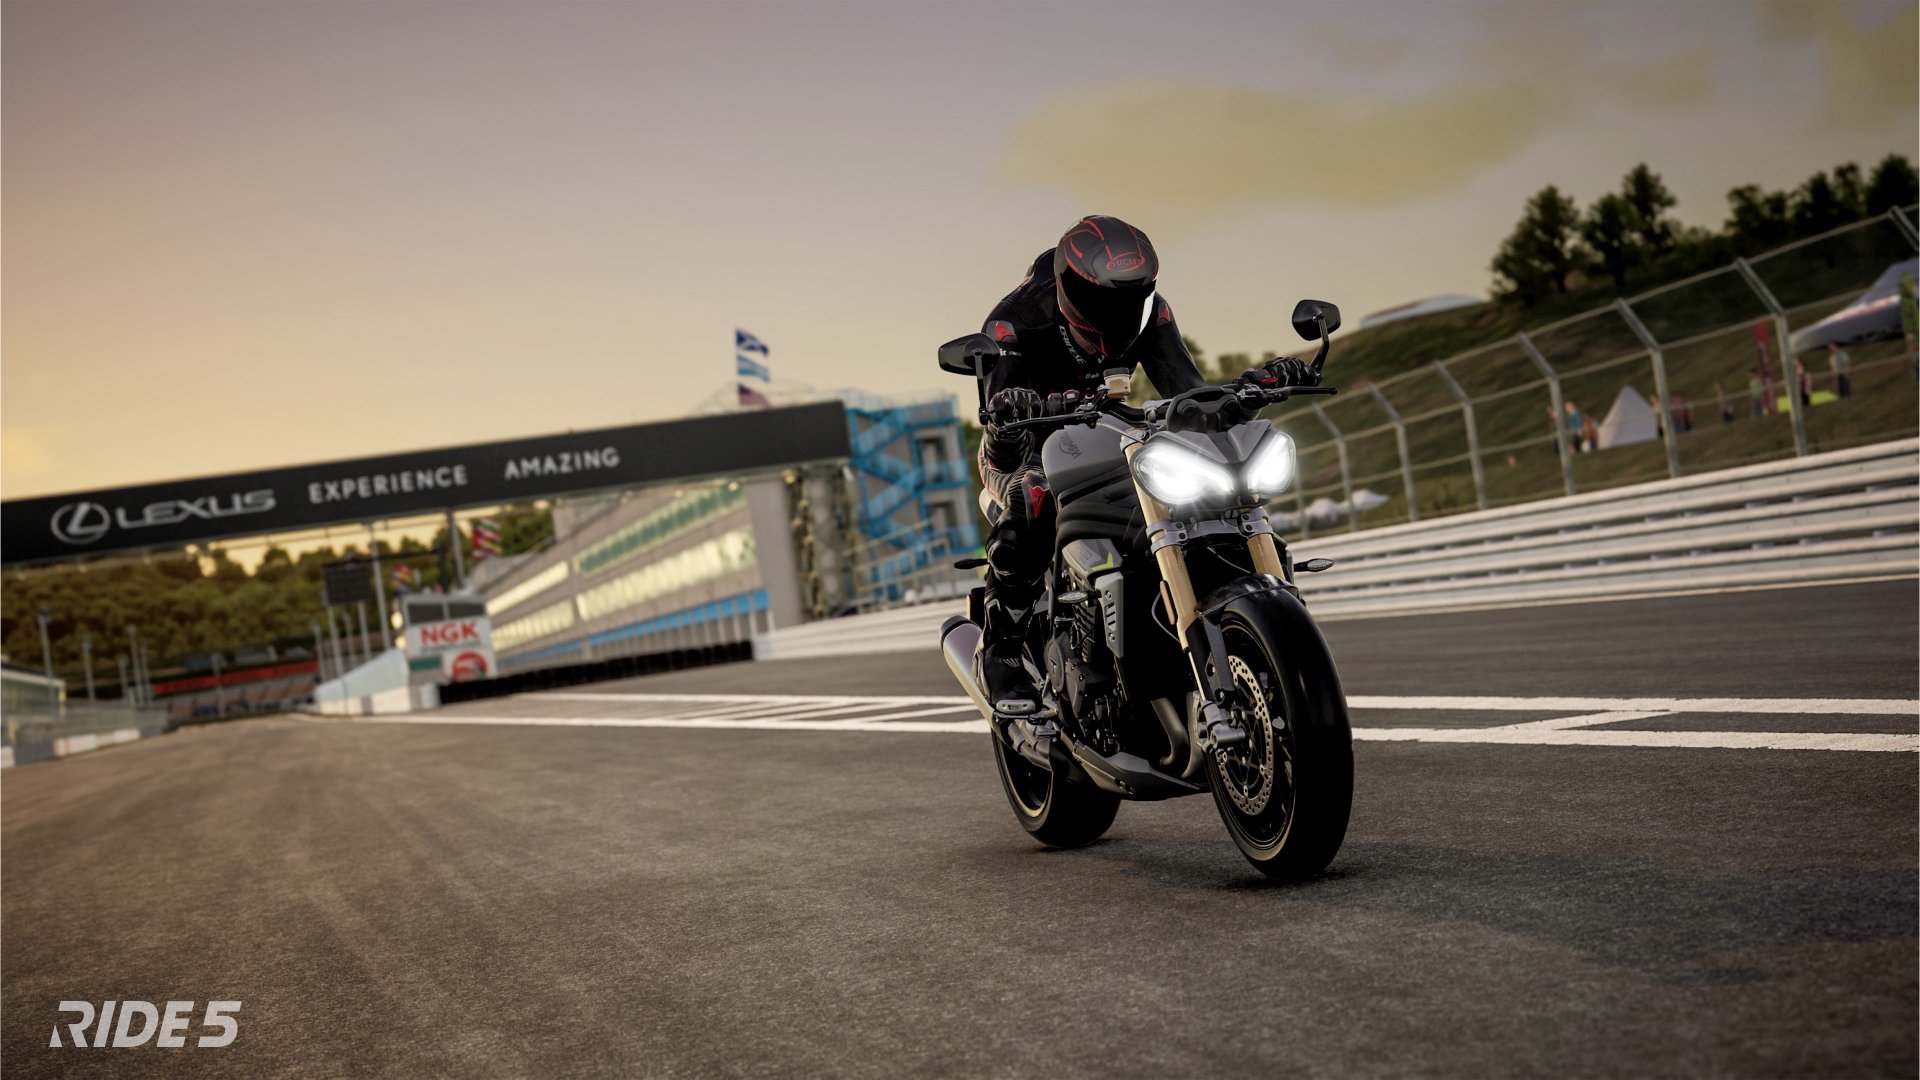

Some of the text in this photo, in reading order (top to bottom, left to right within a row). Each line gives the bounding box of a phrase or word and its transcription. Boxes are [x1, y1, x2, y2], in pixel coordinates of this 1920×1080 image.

[115, 447, 621, 529] LEXUS EXPERIENCE AMAZING
[421, 619, 481, 645] NGK
